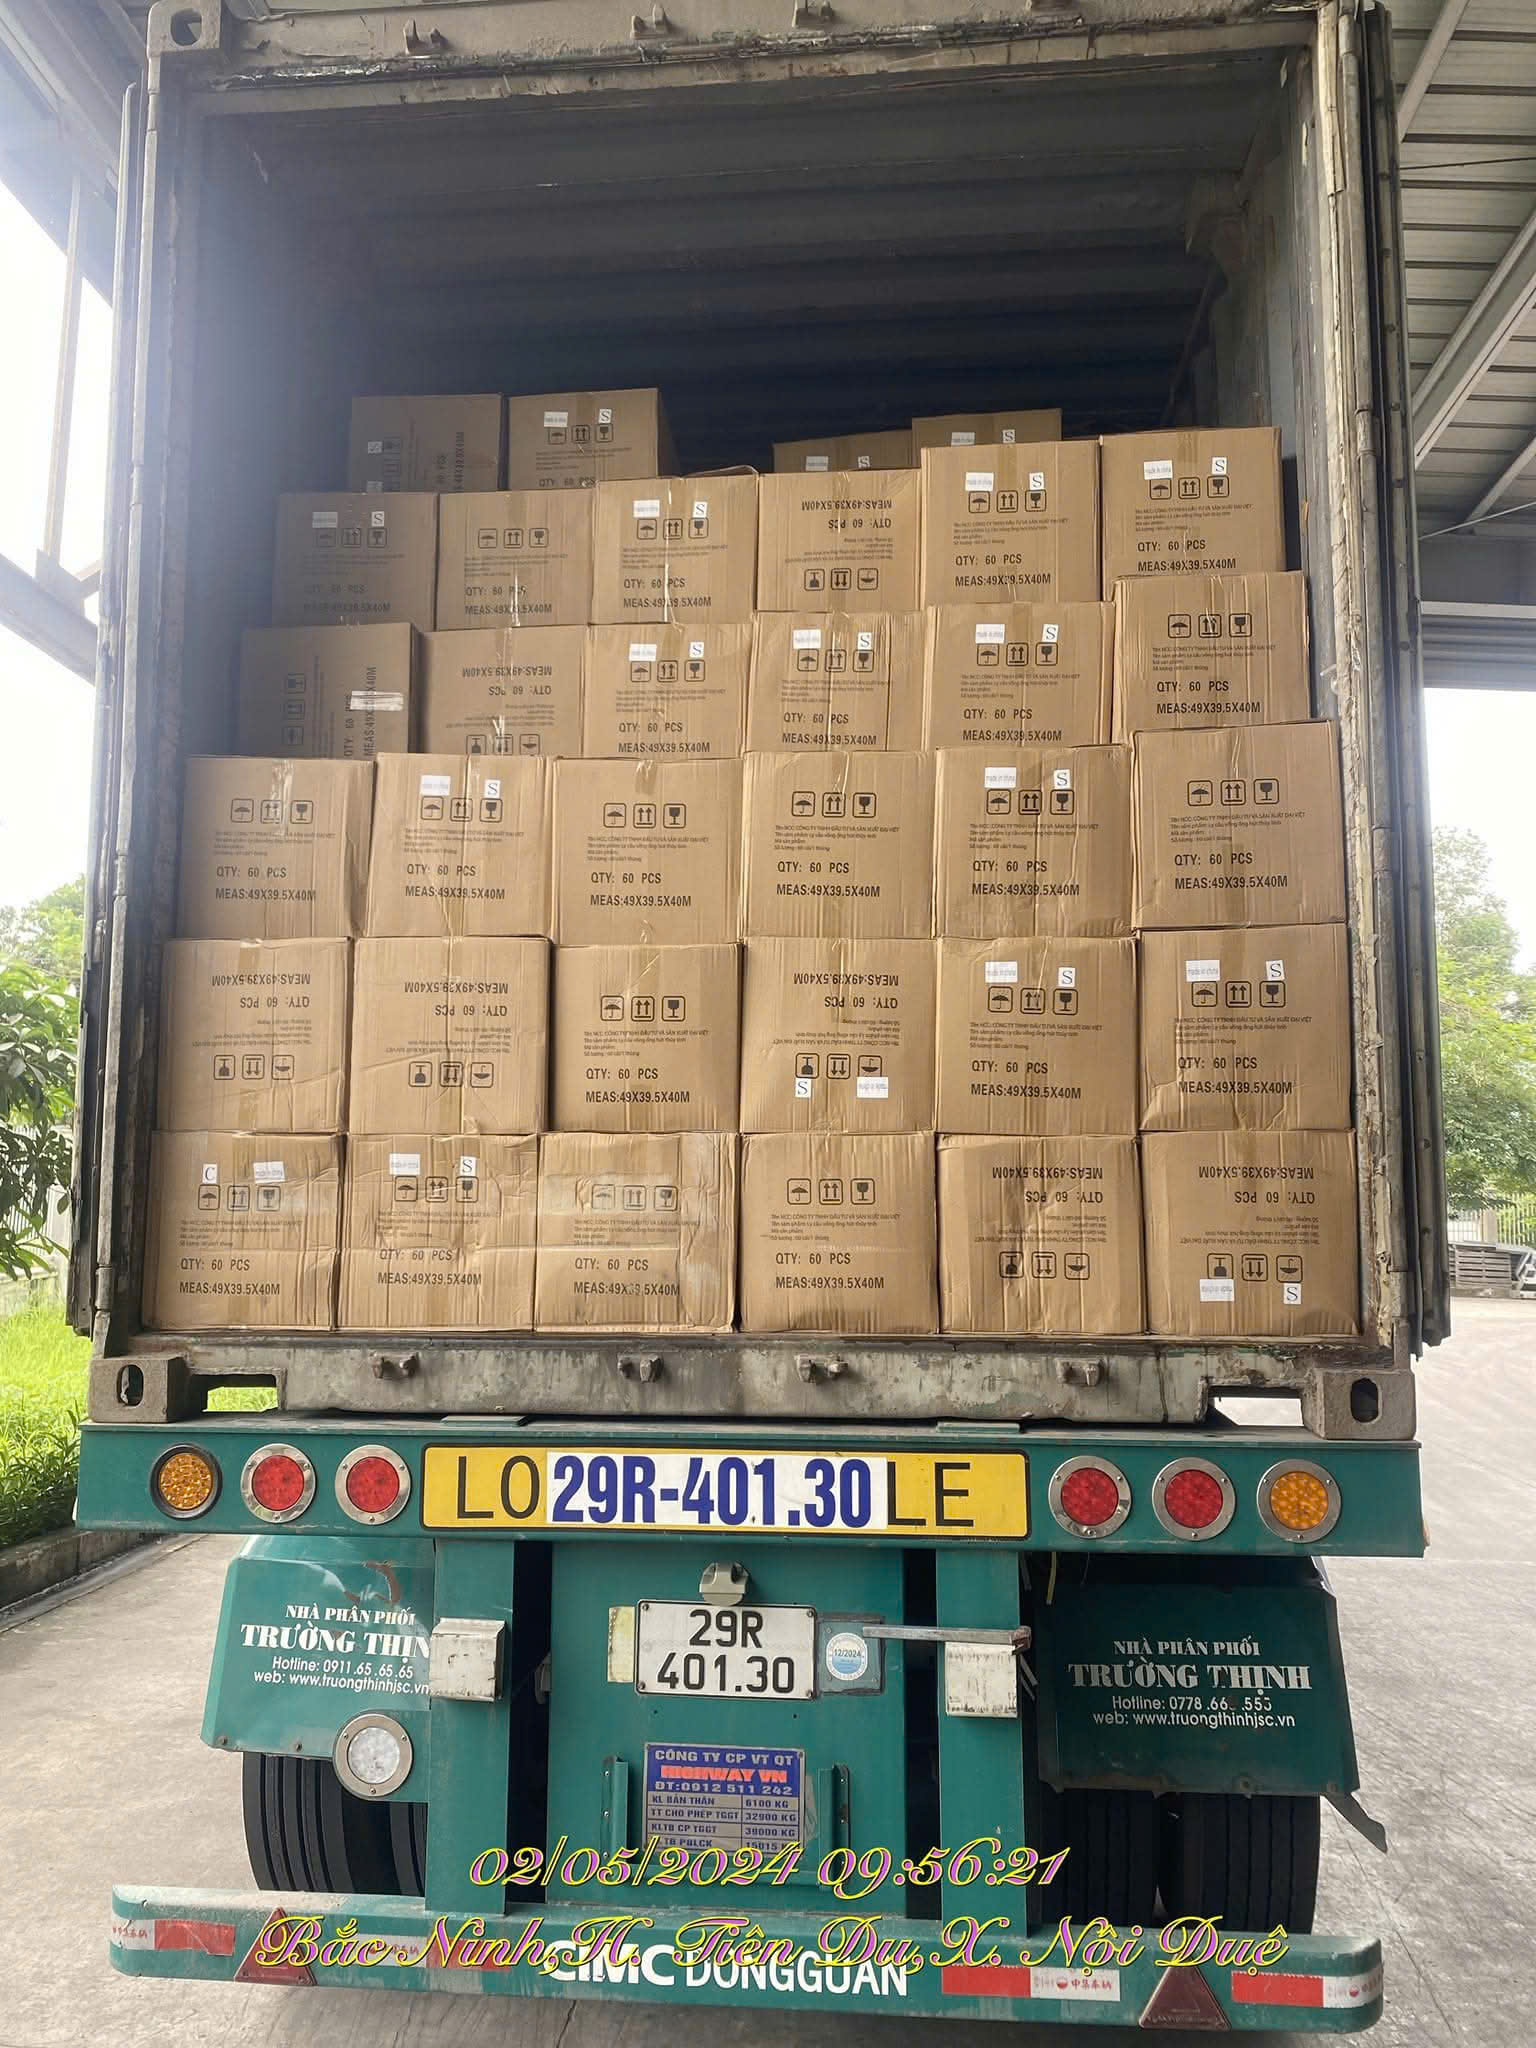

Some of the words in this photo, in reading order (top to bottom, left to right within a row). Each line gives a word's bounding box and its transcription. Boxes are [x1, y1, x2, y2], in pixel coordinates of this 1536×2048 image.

[1215, 460, 1225, 472] S
[1031, 474, 1043, 488] S
[1137, 541, 1161, 552] QTY:
[1168, 540, 1179, 551] 60
[1186, 539, 1206, 551] PCS
[955, 554, 979, 566] QTY:
[985, 554, 997, 566] 60
[1003, 553, 1022, 565] PCS
[1046, 626, 1057, 640] S
[1156, 681, 1181, 693] QTY:
[1189, 680, 1201, 692] 60
[1208, 680, 1229, 692] PCS
[963, 708, 987, 721] QTY:
[994, 708, 1006, 721] 60
[1013, 708, 1033, 721] PCS
[618, 722, 641, 734] QTY:
[647, 722, 659, 733] 60
[664, 722, 683, 734] PCS
[1057, 772, 1068, 786] S
[1174, 854, 1201, 866] QTY:
[1209, 853, 1222, 865] 60
[1231, 852, 1253, 864] PCS
[407, 864, 431, 877] QTY:
[437, 864, 449, 876] 60
[456, 864, 476, 877] PCS
[777, 861, 802, 873] QTY:
[809, 862, 821, 874] 60
[829, 862, 849, 874] PCS
[972, 860, 998, 873] QTY:
[1006, 860, 1018, 873] 60
[1026, 860, 1047, 873] PCS
[591, 872, 615, 884] QTY:
[622, 872, 634, 884] 60
[641, 872, 662, 884] PCS
[1175, 875, 1288, 890] MEAS:49X39.5X40M
[776, 884, 880, 898] MEAS:49X39.5X40M
[590, 894, 691, 907] MEAS:49X39.5X40M
[1270, 963, 1282, 978] S
[1062, 970, 1073, 985] S
[240, 997, 260, 1009] PCS
[266, 997, 278, 1009] 60
[824, 996, 845, 1009] PCS
[853, 997, 865, 1009] 60
[463, 1005, 475, 1017] 60
[971, 1060, 998, 1072] QTY:
[1006, 1061, 1018, 1073] 60
[1026, 1062, 1048, 1074] PCS
[1177, 1057, 1205, 1069] QTY:
[1213, 1057, 1226, 1069] 60
[1235, 1057, 1258, 1069] PCS
[586, 1068, 610, 1081] QTY:
[618, 1068, 630, 1080] 60
[638, 1068, 659, 1081] PCS
[585, 1090, 690, 1104] MEAS:49X39.5X40M
[970, 1083, 1081, 1099] MEAS:49X39.5X40M
[204, 1166, 215, 1181] C
[1234, 1191, 1257, 1203] PCS
[1266, 1191, 1279, 1203] 60
[1287, 1191, 1315, 1204] QTY:
[379, 1249, 406, 1262] QTY:
[411, 1249, 424, 1262] 60
[775, 1252, 801, 1265] QTY:
[809, 1252, 822, 1265] 60
[829, 1252, 851, 1265] PCS
[180, 1258, 205, 1270] QTY:
[211, 1259, 223, 1271] 60
[230, 1259, 250, 1271] PCS
[179, 1282, 280, 1295] MEAS:49X39.5X40M
[775, 1276, 885, 1289] MEAS:49X39.5X40M
[1287, 1286, 1298, 1301] S
[552, 1455, 871, 1528] 29R-401.30
[285, 1603, 320, 1620] NHÀ
[324, 1605, 370, 1623] PHÂN
[373, 1606, 417, 1625] PHỐI
[689, 1609, 763, 1649] 29R
[240, 1620, 356, 1654] TRƯỜNG
[363, 1632, 430, 1664] THỊN
[1113, 1637, 1153, 1656] NHÀ
[1157, 1638, 1208, 1656] PHÂN
[1213, 1635, 1261, 1656] PHỐI
[834, 1648, 861, 1658] 12/2024
[272, 1655, 320, 1672] Hotline:
[254, 1670, 286, 1684] web:
[657, 1652, 795, 1694] 401.30
[1068, 1656, 1199, 1689] TRƯỜNG
[1206, 1664, 1312, 1696] THỊNH
[1112, 1695, 1165, 1711] Hotline:
[1093, 1711, 1128, 1725] web:
[1133, 1711, 1296, 1730] www.truongthinhjsc.vn
[702, 1752, 721, 1762] TY
[725, 1752, 747, 1763] CP
[751, 1754, 769, 1765] VT
[774, 1755, 793, 1766] QT
[727, 1783, 755, 1793] 511
[761, 1785, 793, 1795] 242
[775, 1800, 788, 1809] KG
[781, 1814, 796, 1822] KG
[781, 1829, 795, 1837] KG
[547, 1939, 676, 1986] CIMC
[686, 1949, 908, 1996] DONGGUAN
